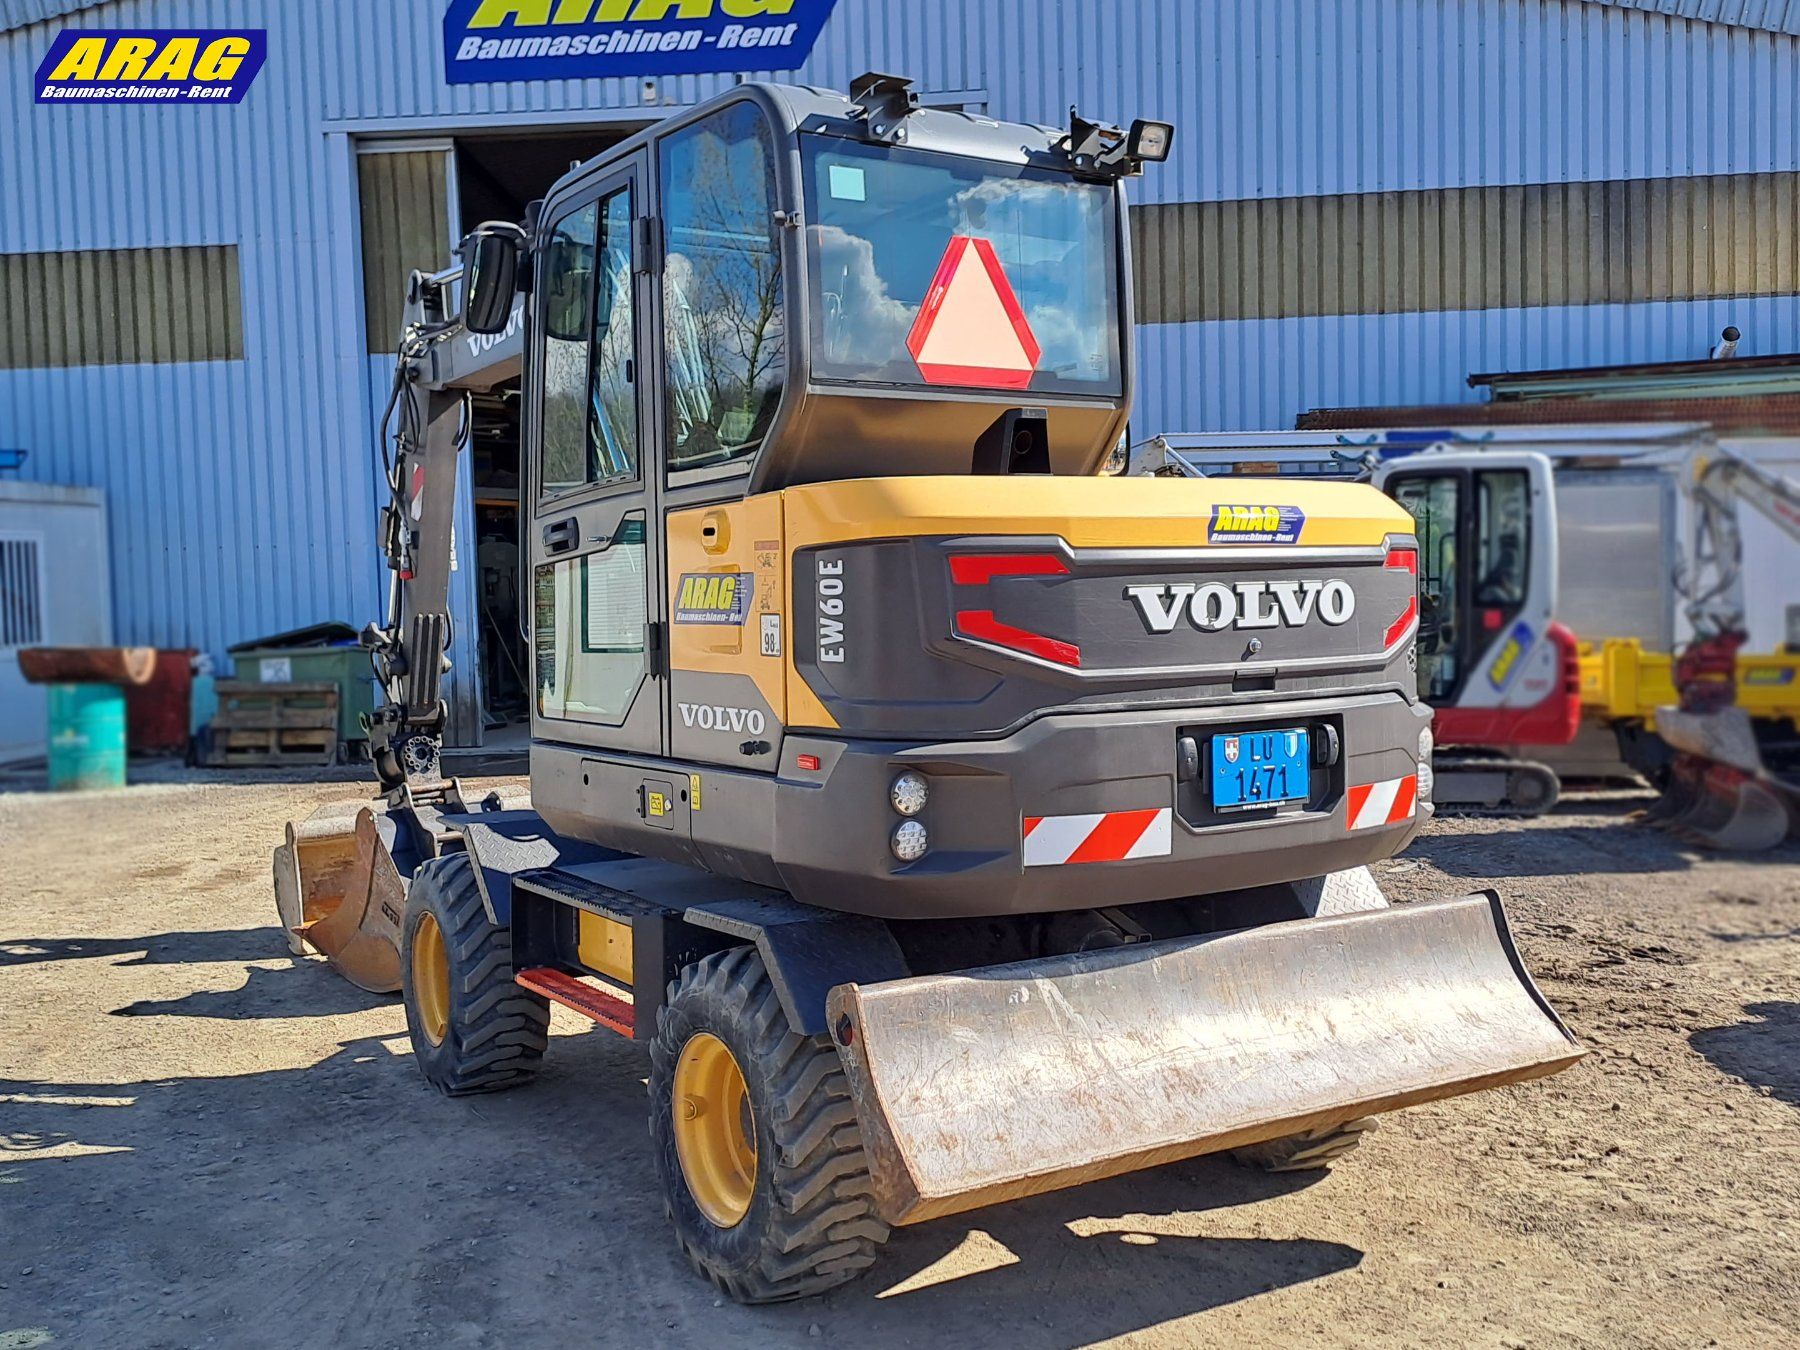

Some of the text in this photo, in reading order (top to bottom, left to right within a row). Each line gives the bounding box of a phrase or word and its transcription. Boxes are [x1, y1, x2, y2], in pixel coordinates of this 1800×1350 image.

[1213, 506, 1280, 532] ARAG
[678, 576, 736, 610] ARAG
[1124, 579, 1356, 633] VOLVO
[818, 559, 845, 663] EW60E
[764, 632, 775, 653] 98
[678, 703, 765, 735] VOLVO
[1250, 734, 1273, 762] LU
[1235, 763, 1289, 802] 1471
